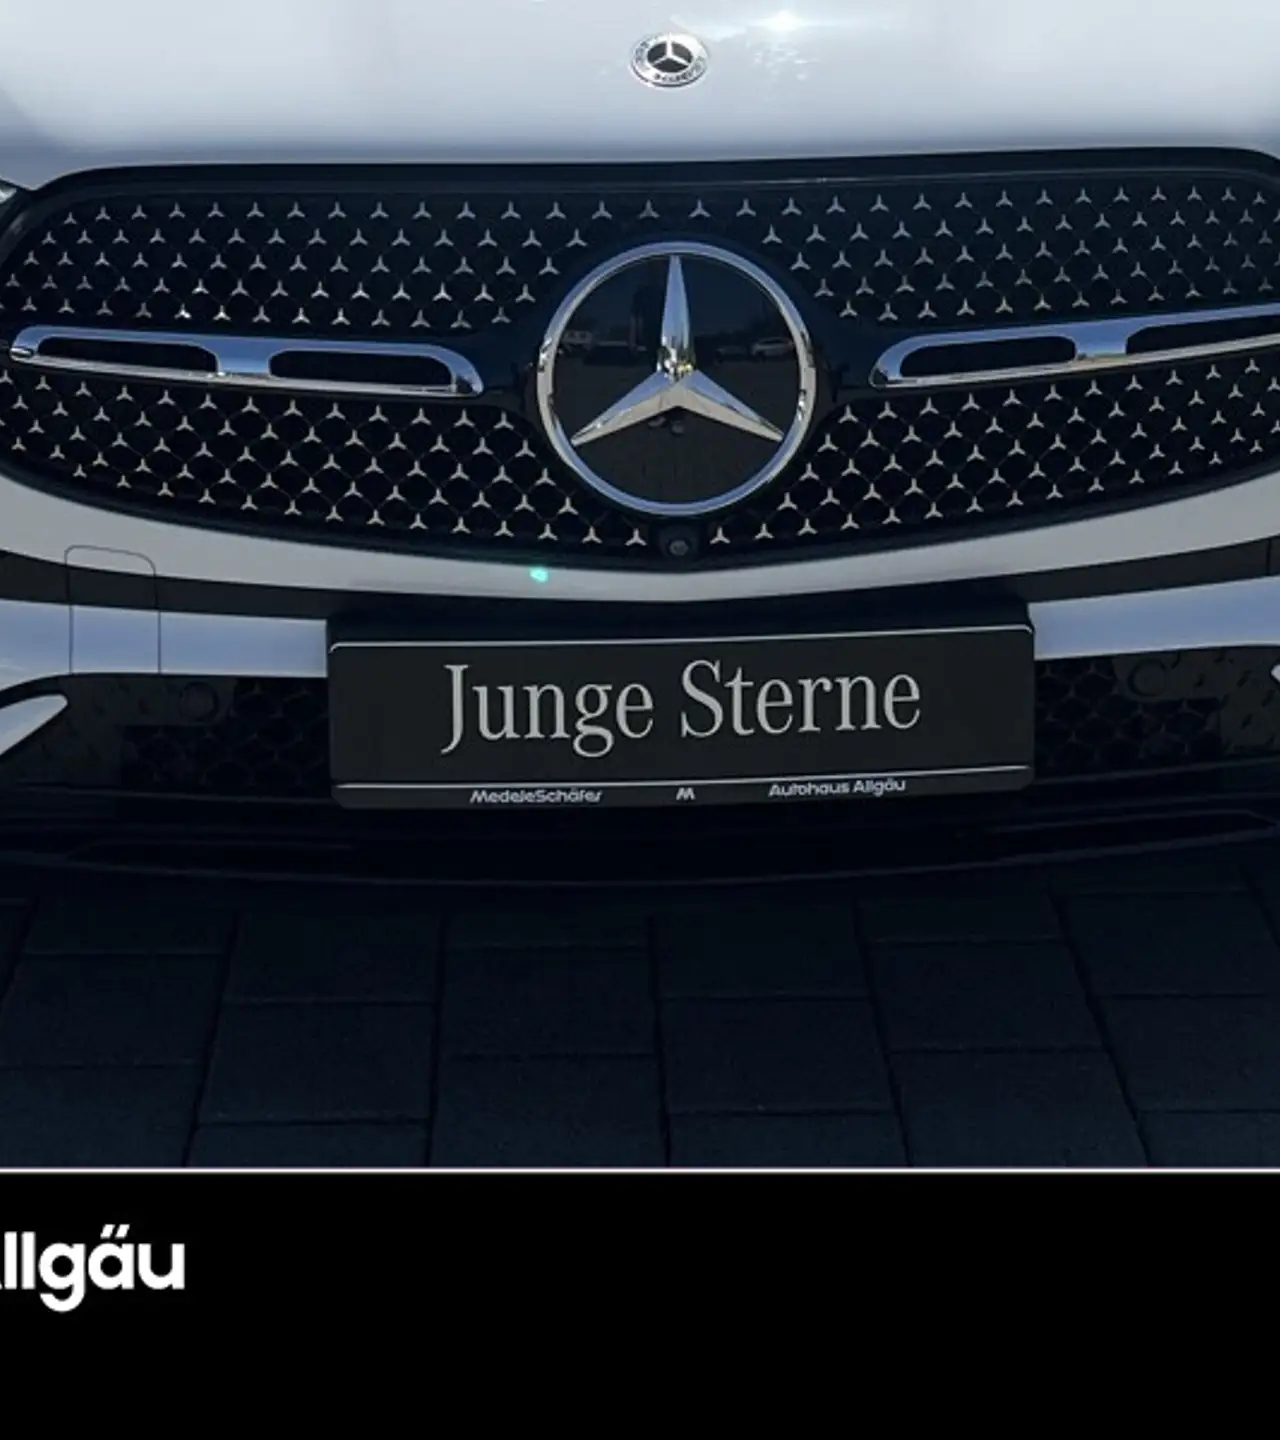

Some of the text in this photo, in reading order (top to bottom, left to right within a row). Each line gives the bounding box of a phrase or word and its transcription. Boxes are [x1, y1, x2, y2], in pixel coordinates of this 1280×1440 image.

[441, 659, 920, 758] Junge Sterne
[470, 786, 603, 804] MedeleSchäfer
[768, 777, 906, 797] Autohaus Allgäu
